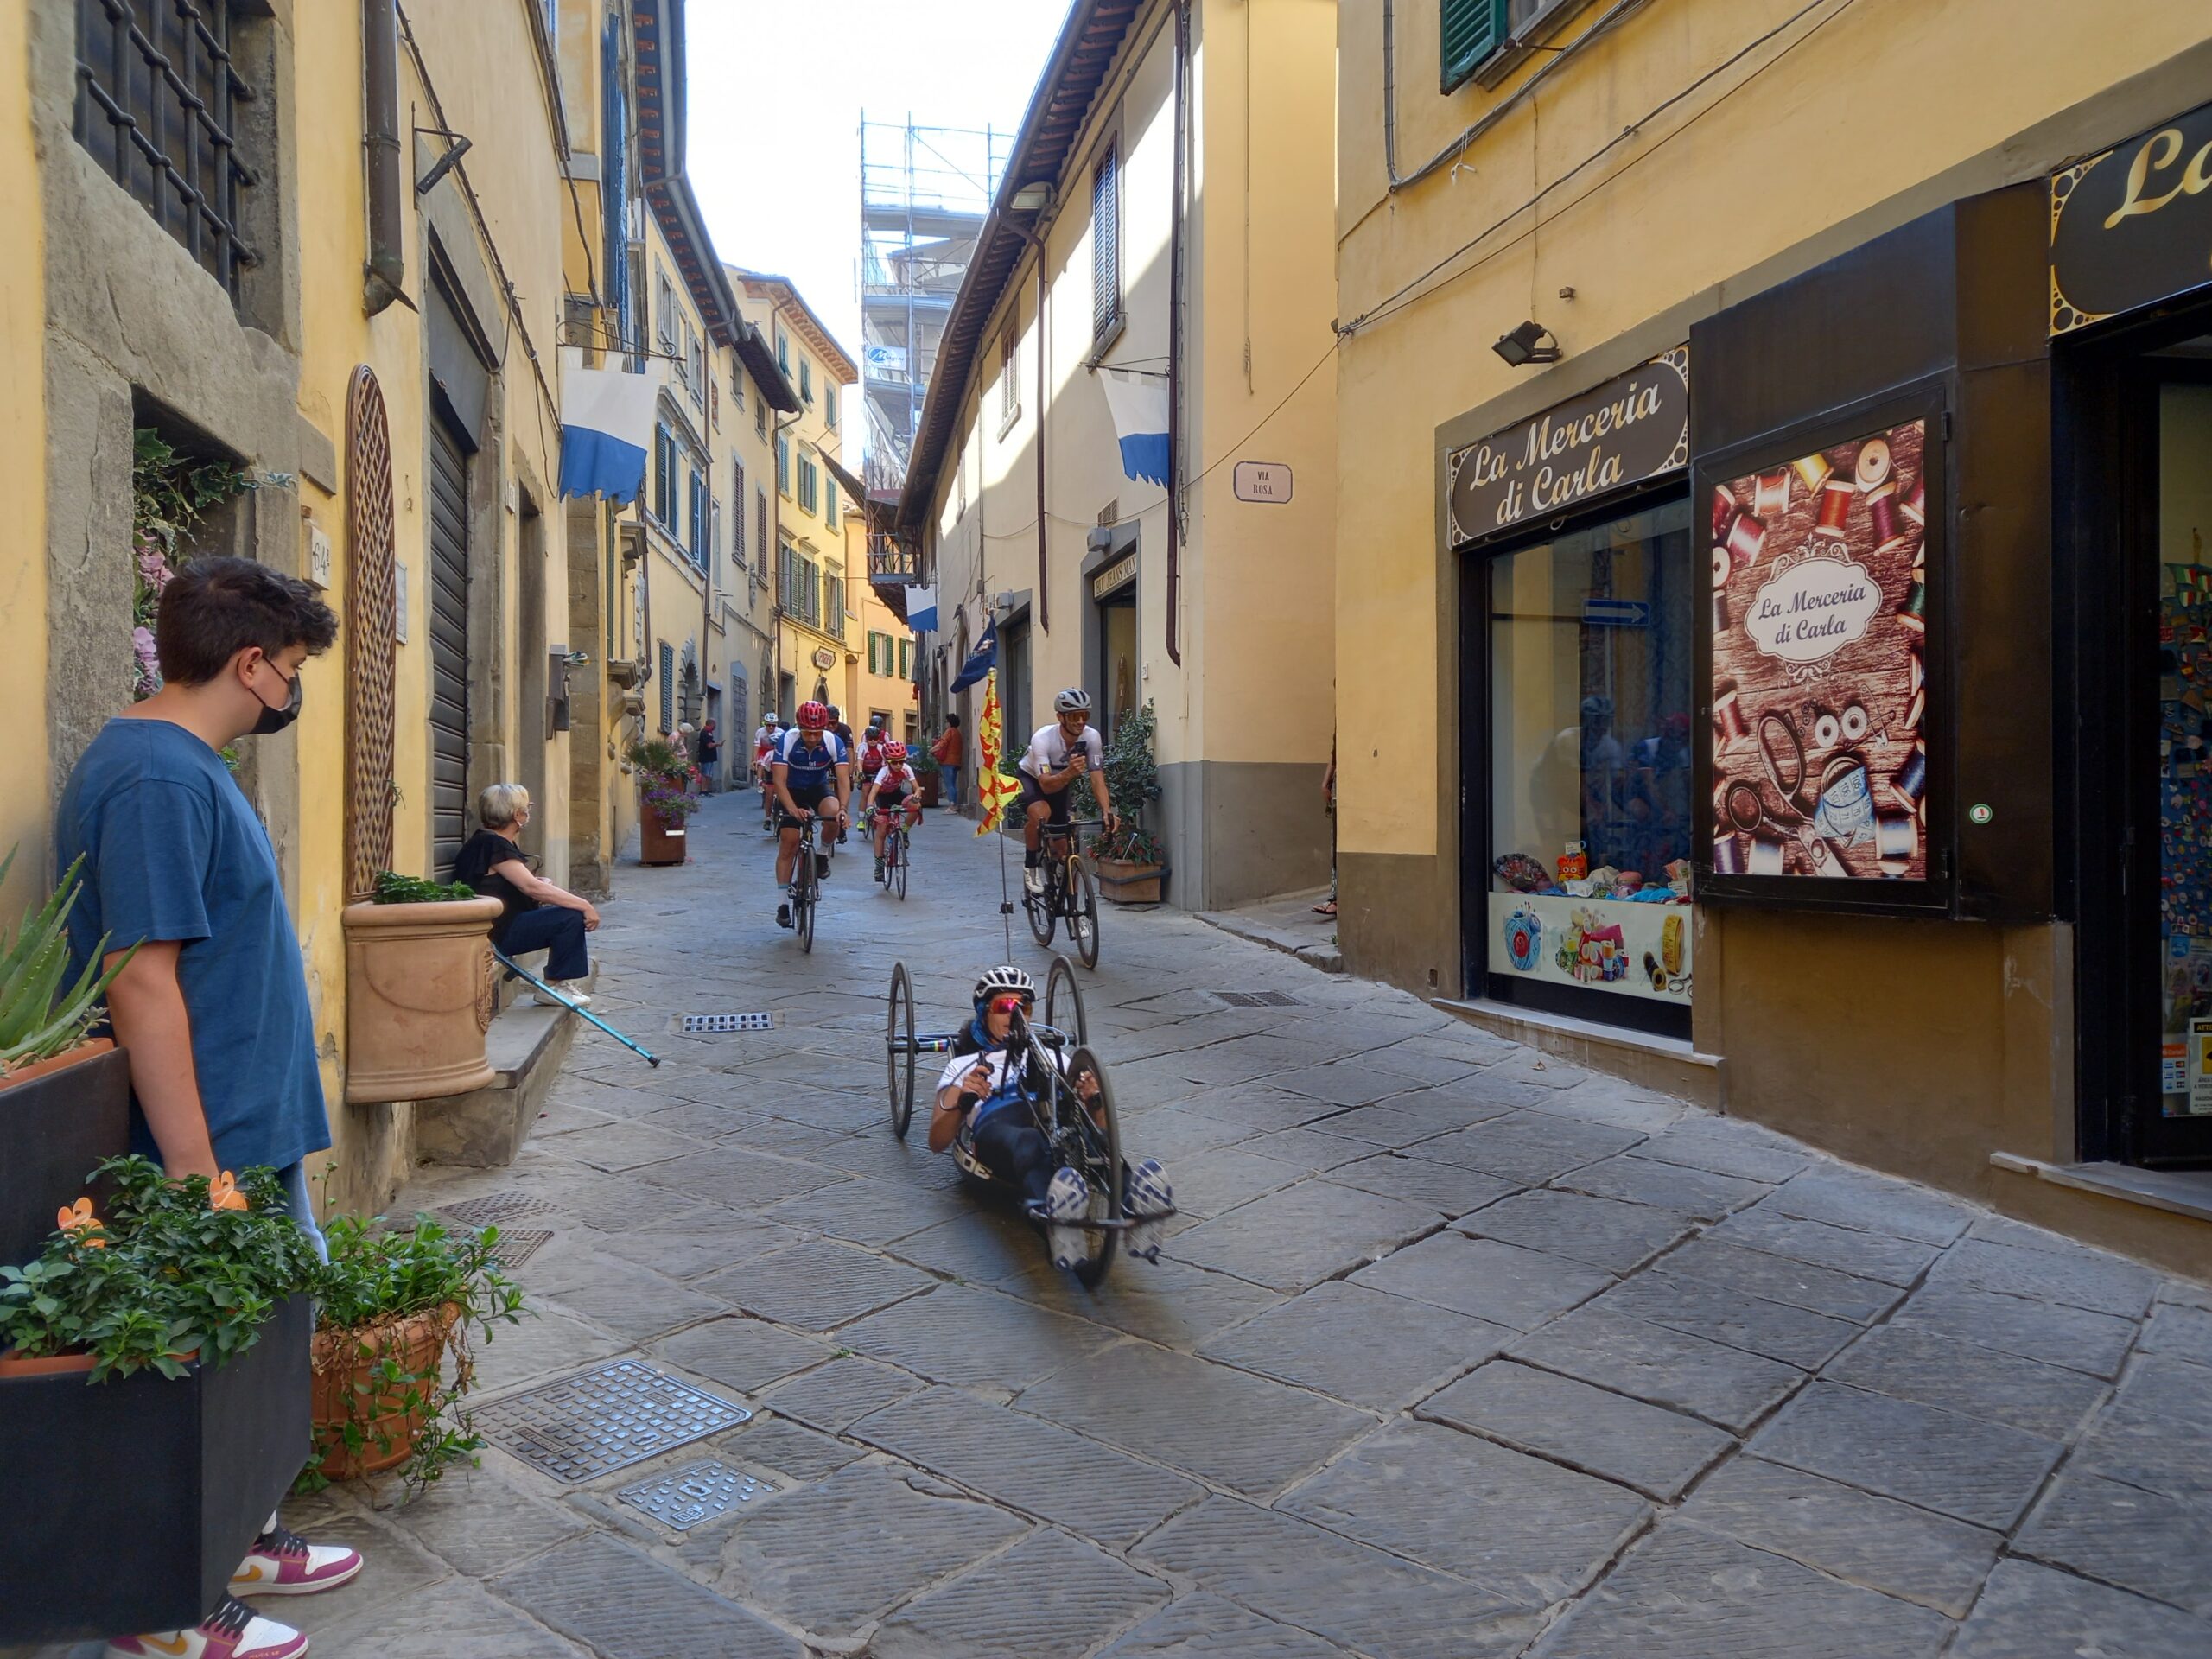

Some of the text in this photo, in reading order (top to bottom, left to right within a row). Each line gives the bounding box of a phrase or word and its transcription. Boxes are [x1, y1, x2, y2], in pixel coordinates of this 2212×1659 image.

[1470, 381, 1662, 490] La Merceria
[1253, 484, 1273, 495] ROSA
[1257, 471, 1269, 481] VIA
[1497, 445, 1624, 524] di Carla
[1758, 583, 1866, 620] La Merceria
[1775, 614, 1847, 645] di Carla
